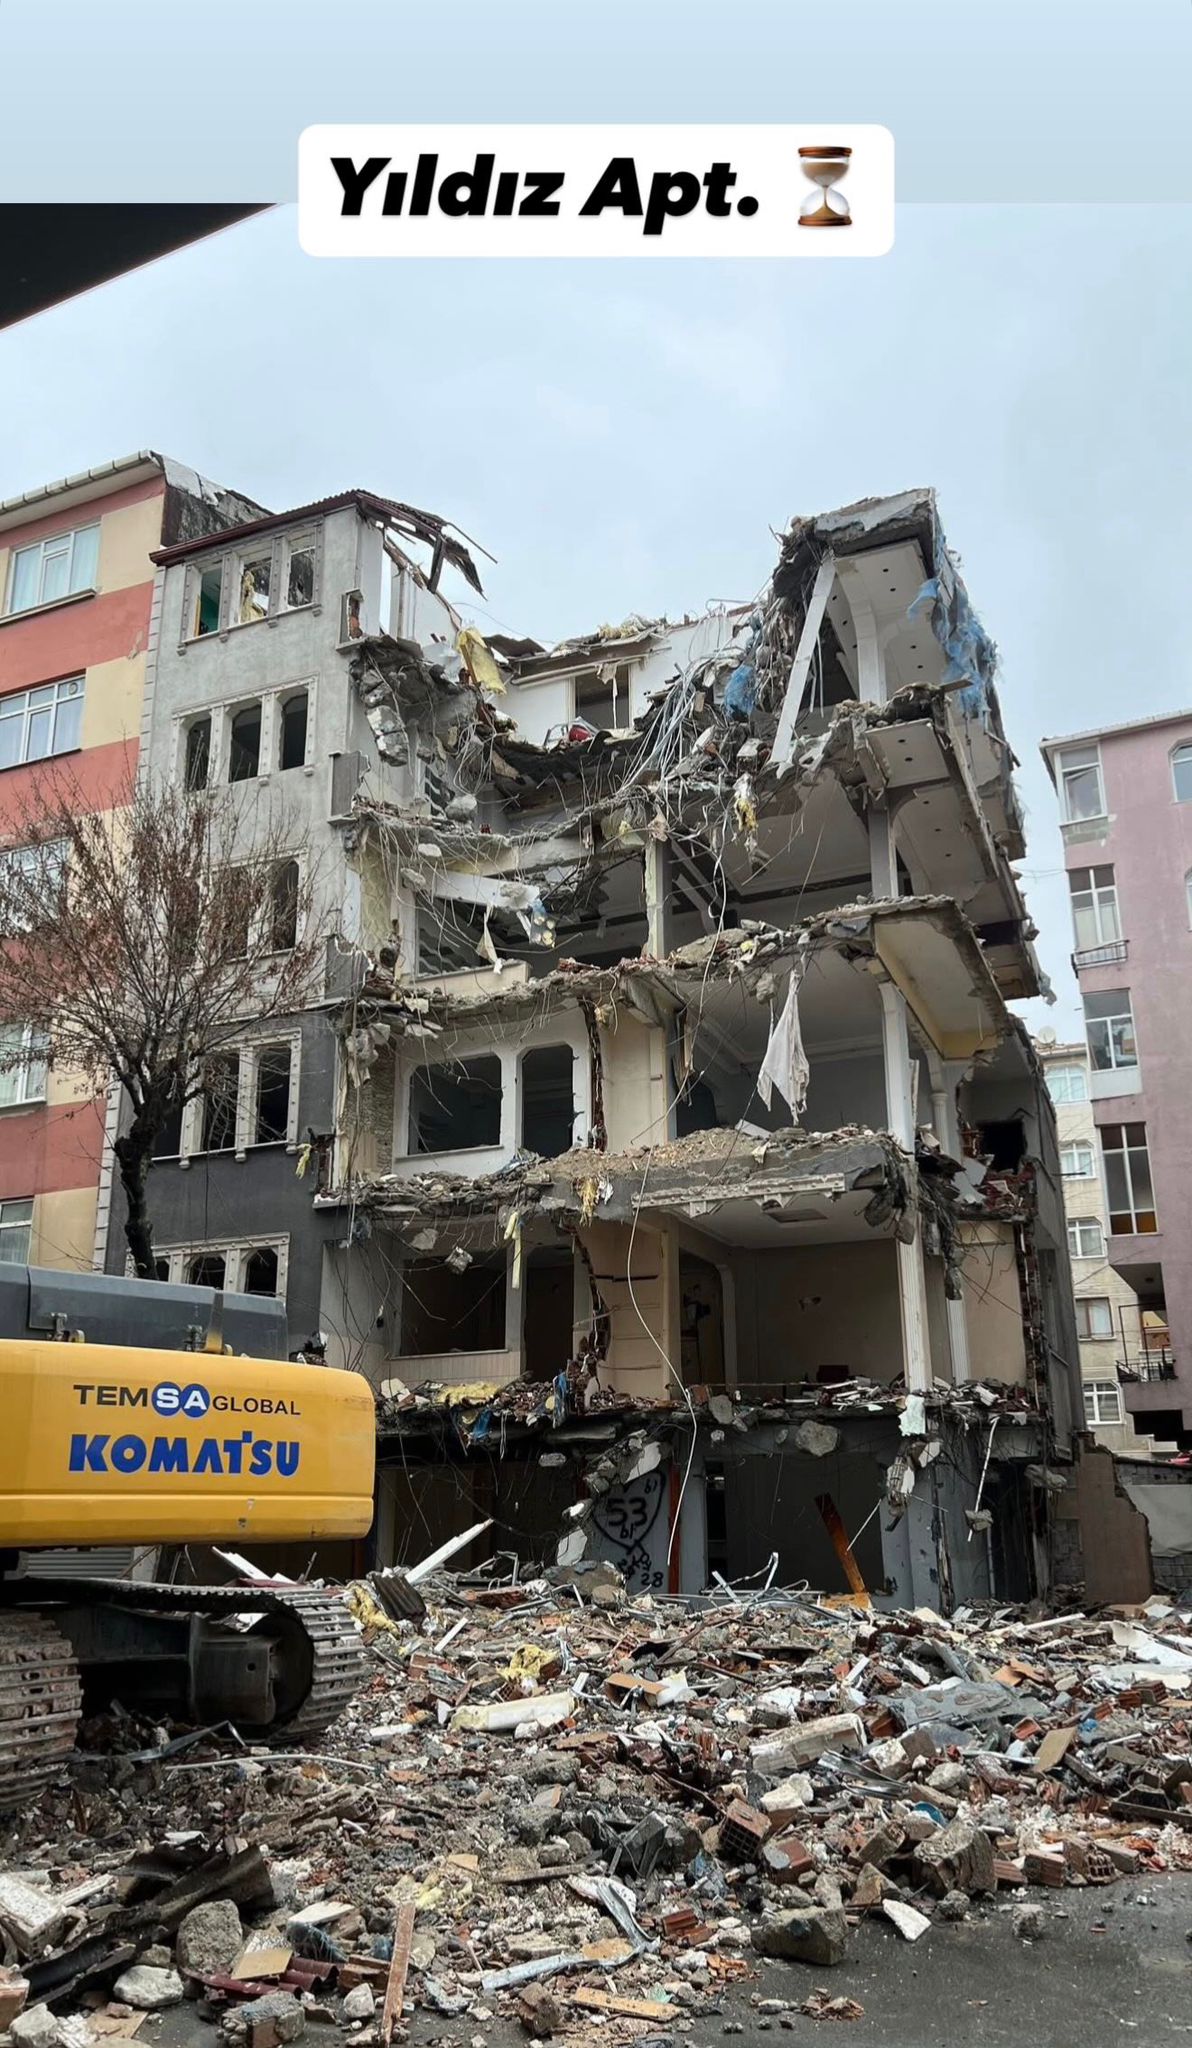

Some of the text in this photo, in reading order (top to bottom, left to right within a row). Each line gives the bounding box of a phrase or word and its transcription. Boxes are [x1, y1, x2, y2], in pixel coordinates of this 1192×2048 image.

[212, 1395, 301, 1416] GLOBAL
[68, 1431, 300, 1477] KOMATSU
[606, 1497, 648, 1527] 53
[640, 1571, 664, 1588] 28
